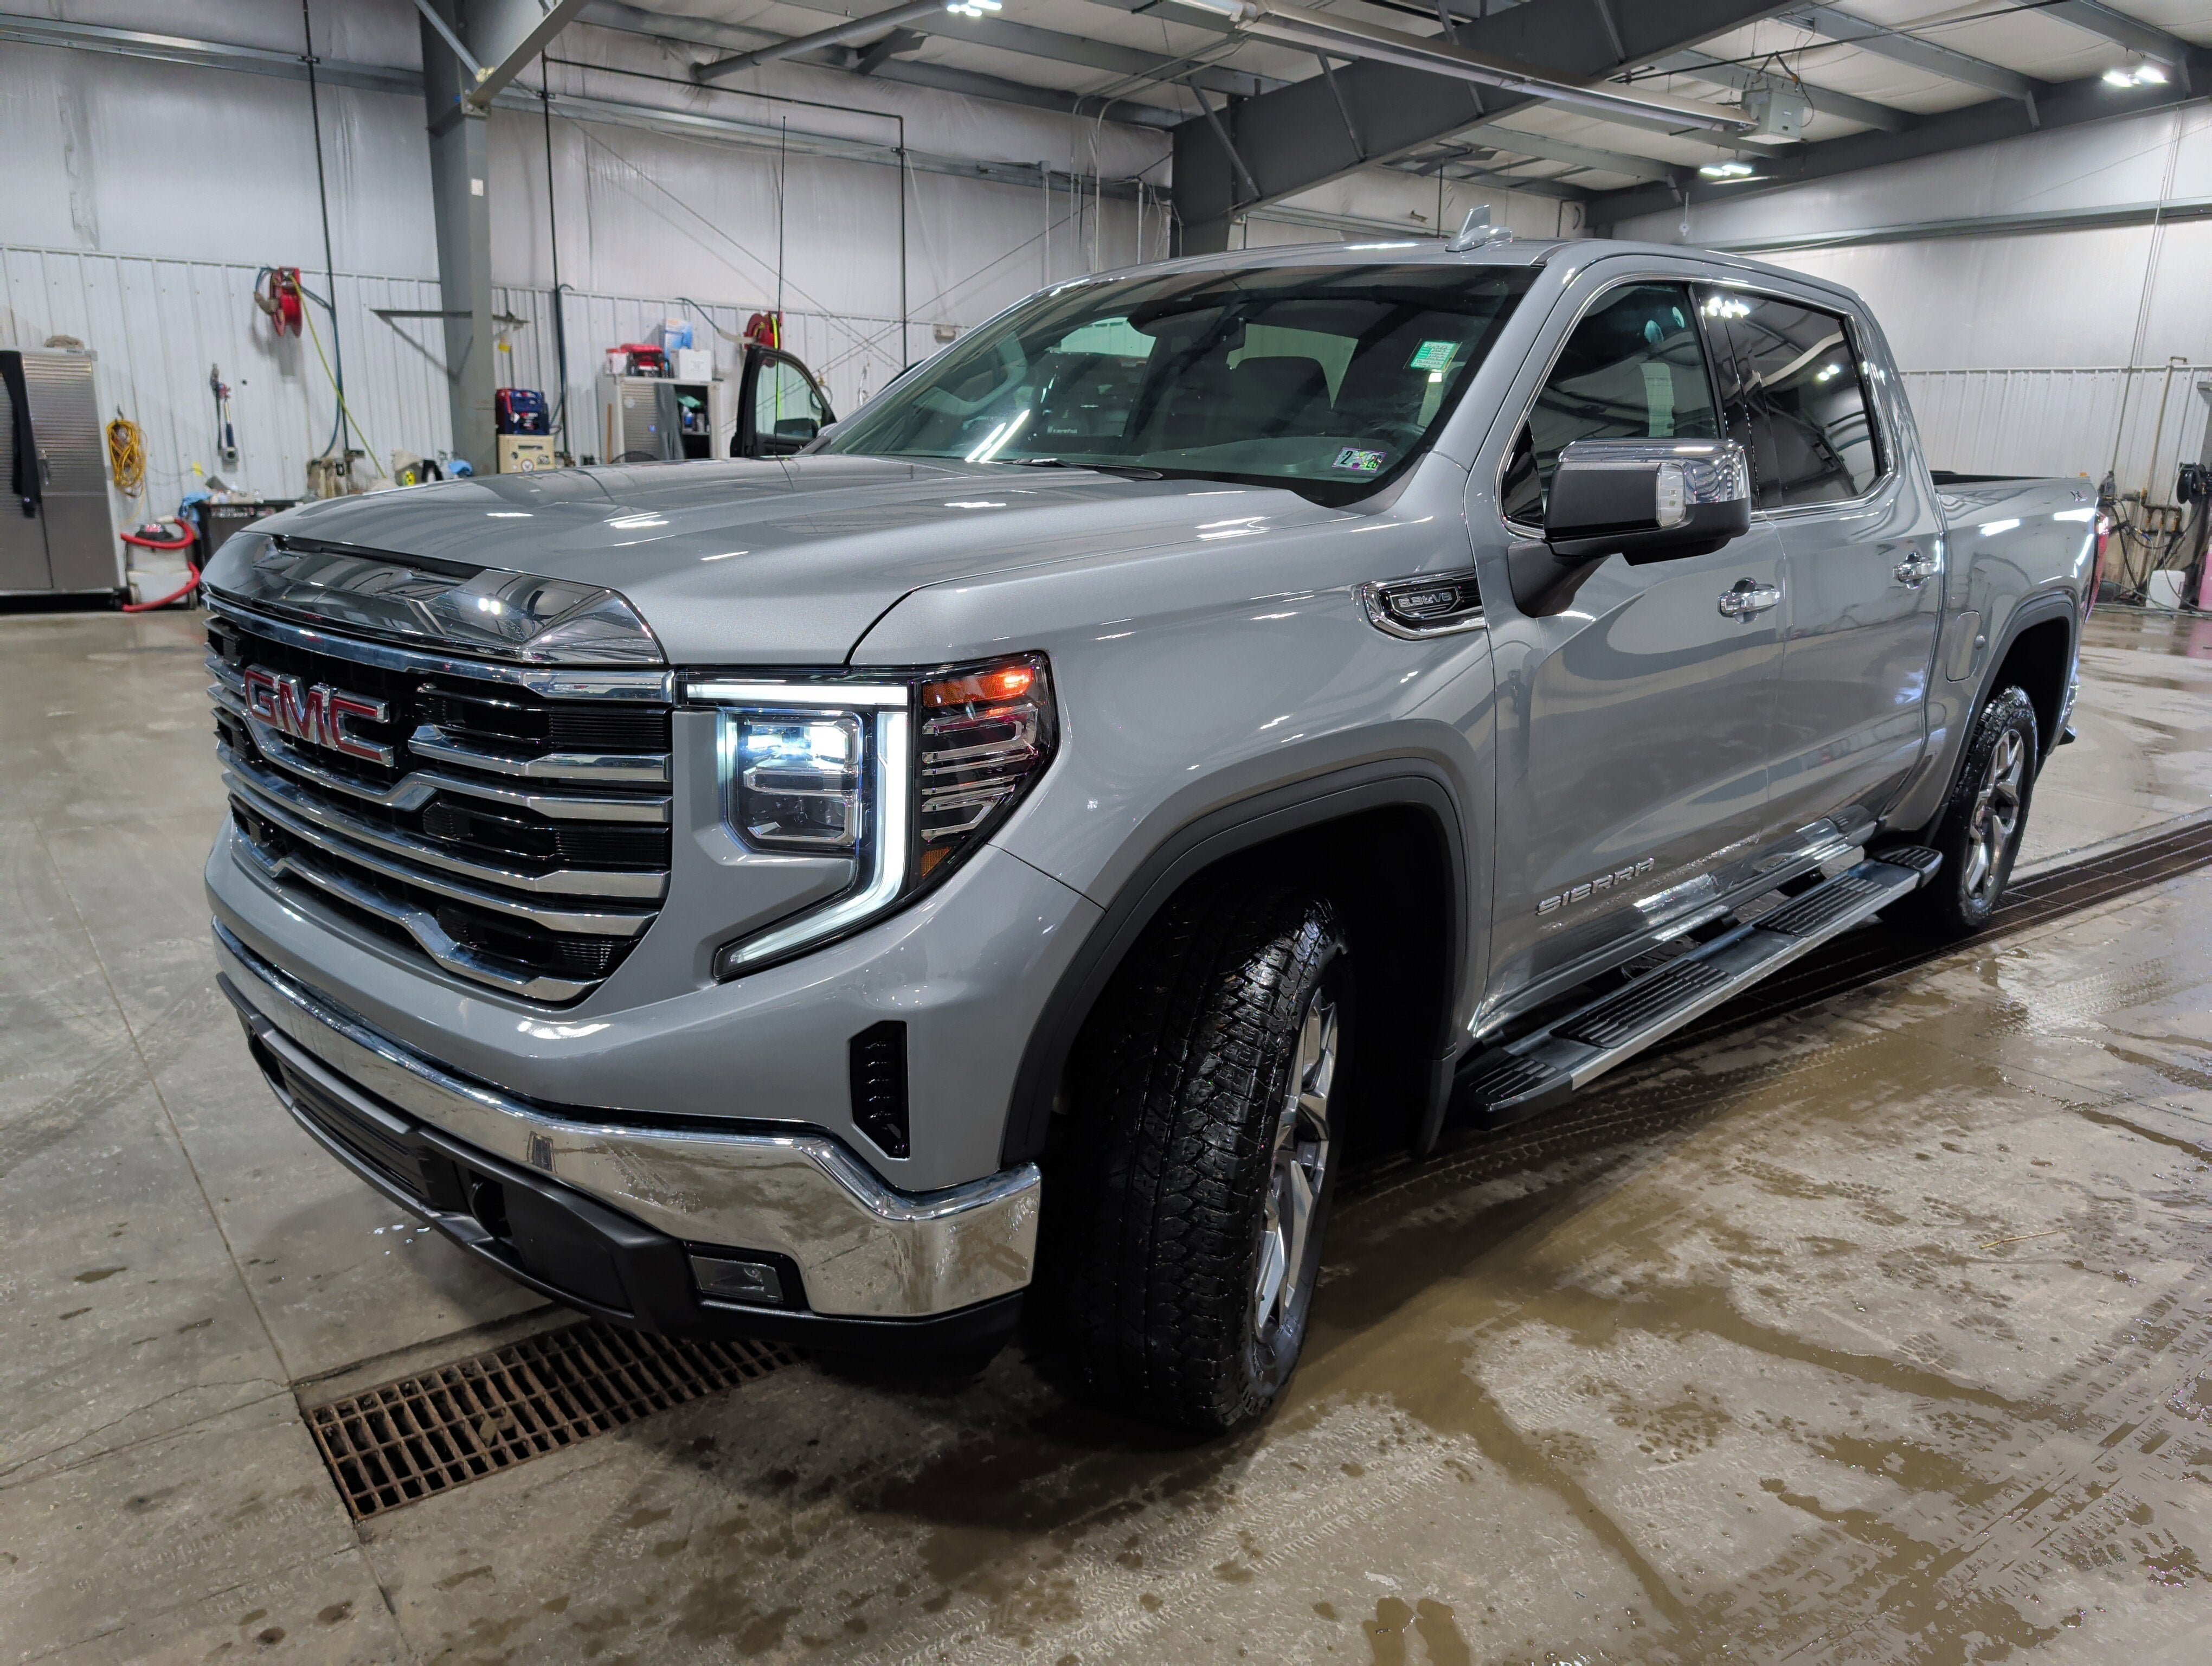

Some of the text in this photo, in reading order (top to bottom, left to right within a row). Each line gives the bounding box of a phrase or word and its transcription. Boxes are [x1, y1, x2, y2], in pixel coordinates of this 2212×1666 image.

[1340, 451, 1353, 465] 2
[243, 664, 394, 767] GMC
[1535, 857, 1655, 915] SIERRA
